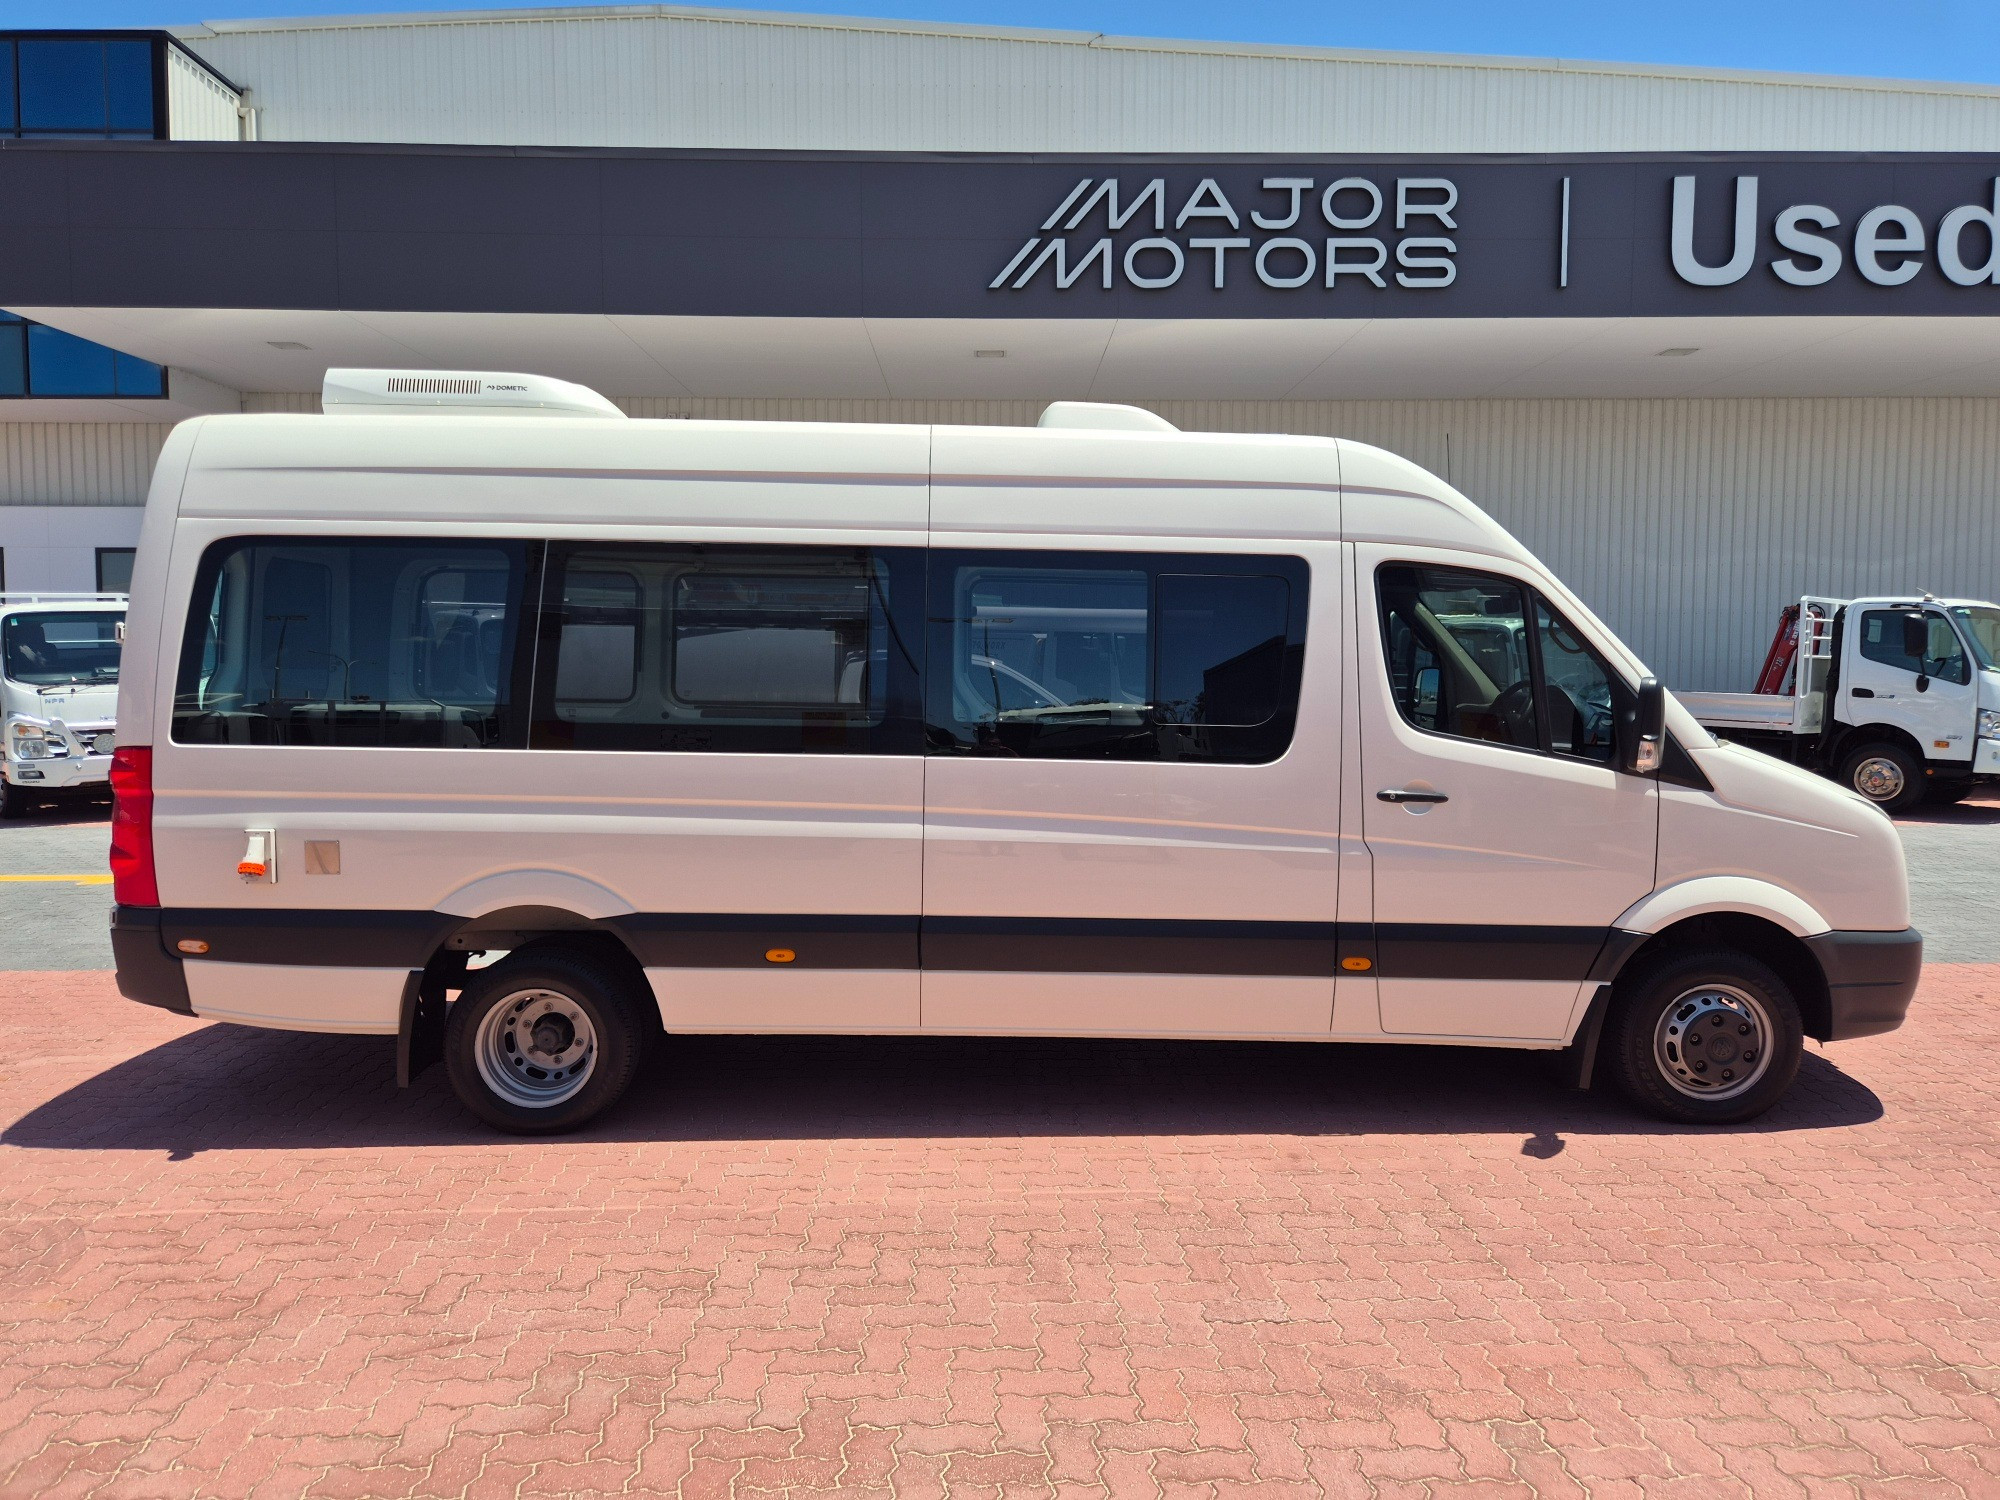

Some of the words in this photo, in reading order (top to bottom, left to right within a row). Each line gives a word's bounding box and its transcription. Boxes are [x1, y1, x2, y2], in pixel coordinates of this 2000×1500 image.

[1040, 177, 1458, 230] MAJOR
[1671, 175, 2000, 286] Used
[988, 237, 1458, 289] MOTORS
[496, 384, 528, 392] DOMETIC
